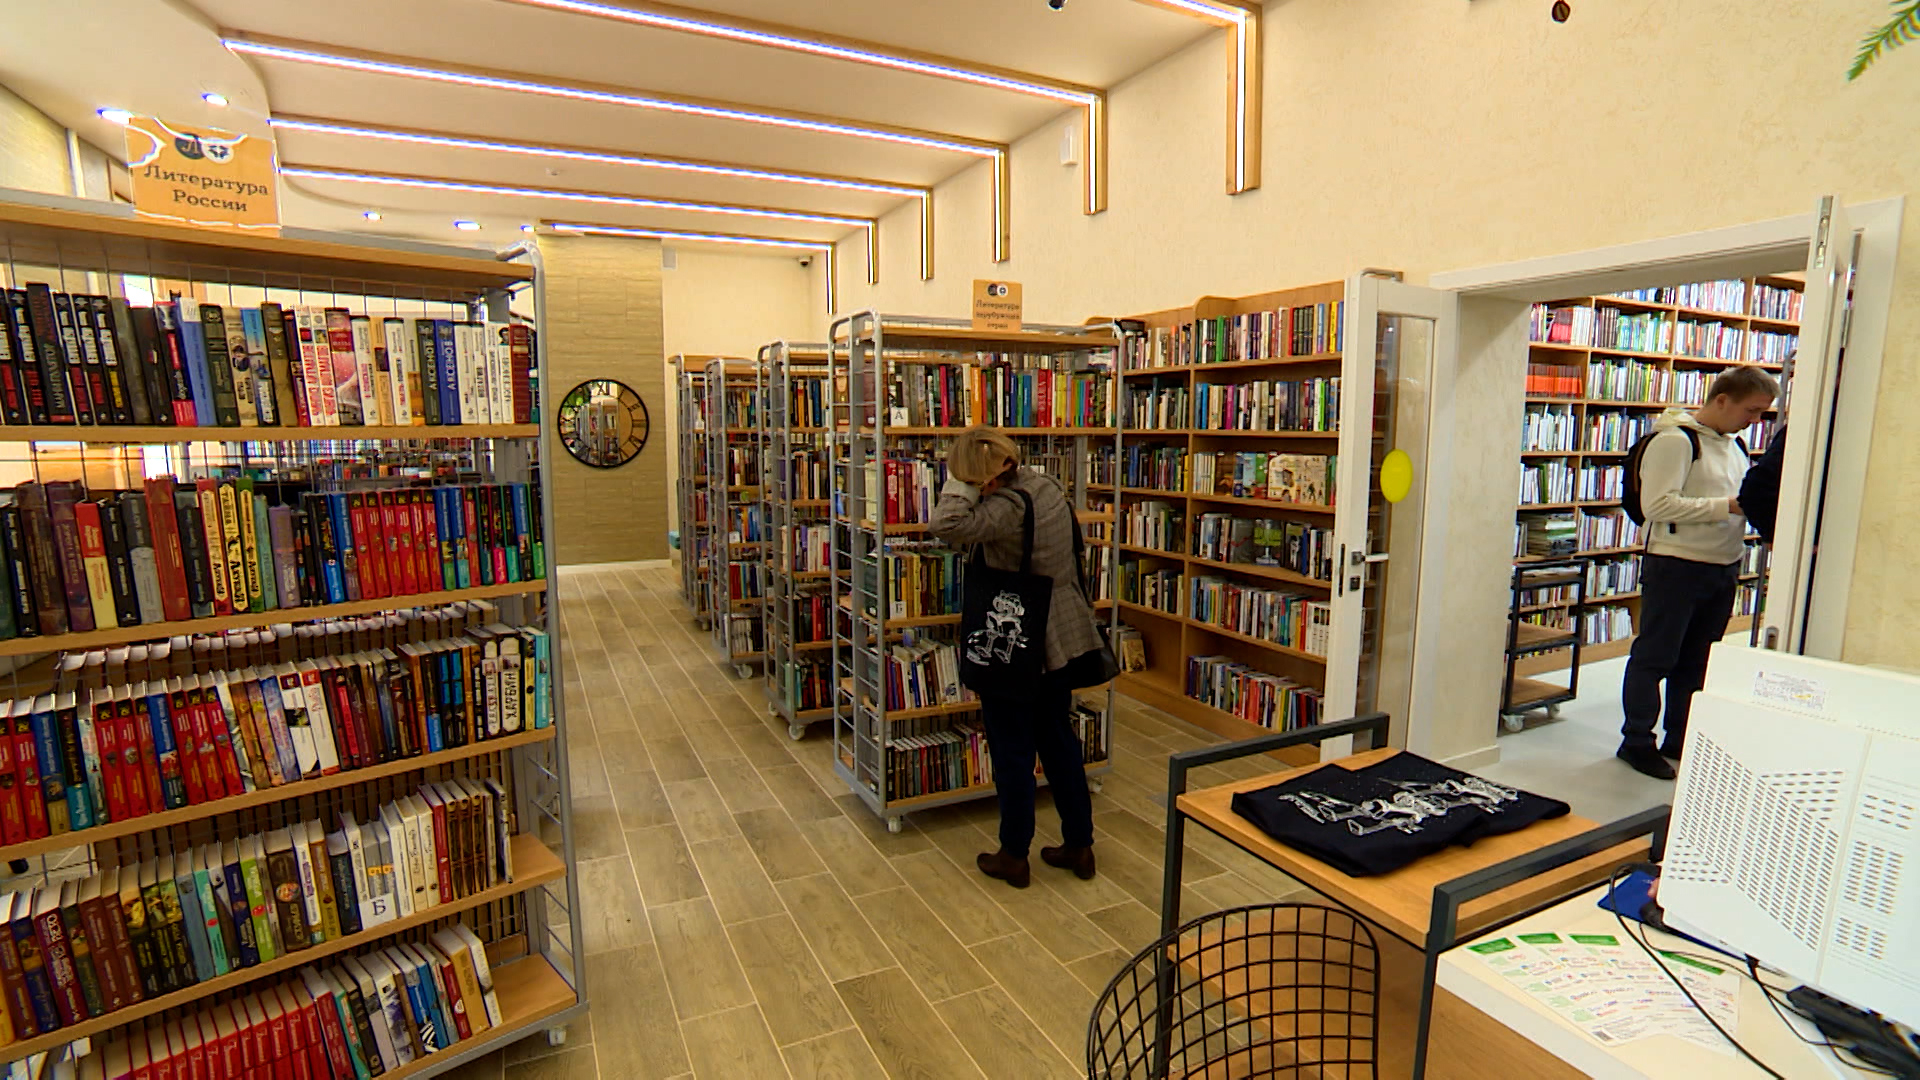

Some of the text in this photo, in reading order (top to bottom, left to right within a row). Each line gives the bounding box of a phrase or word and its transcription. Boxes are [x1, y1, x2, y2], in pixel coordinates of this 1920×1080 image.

[143, 164, 268, 196] Литература
[172, 188, 248, 212] России
[503, 672, 518, 720] ХАРБИН
[371, 899, 386, 916] Б
